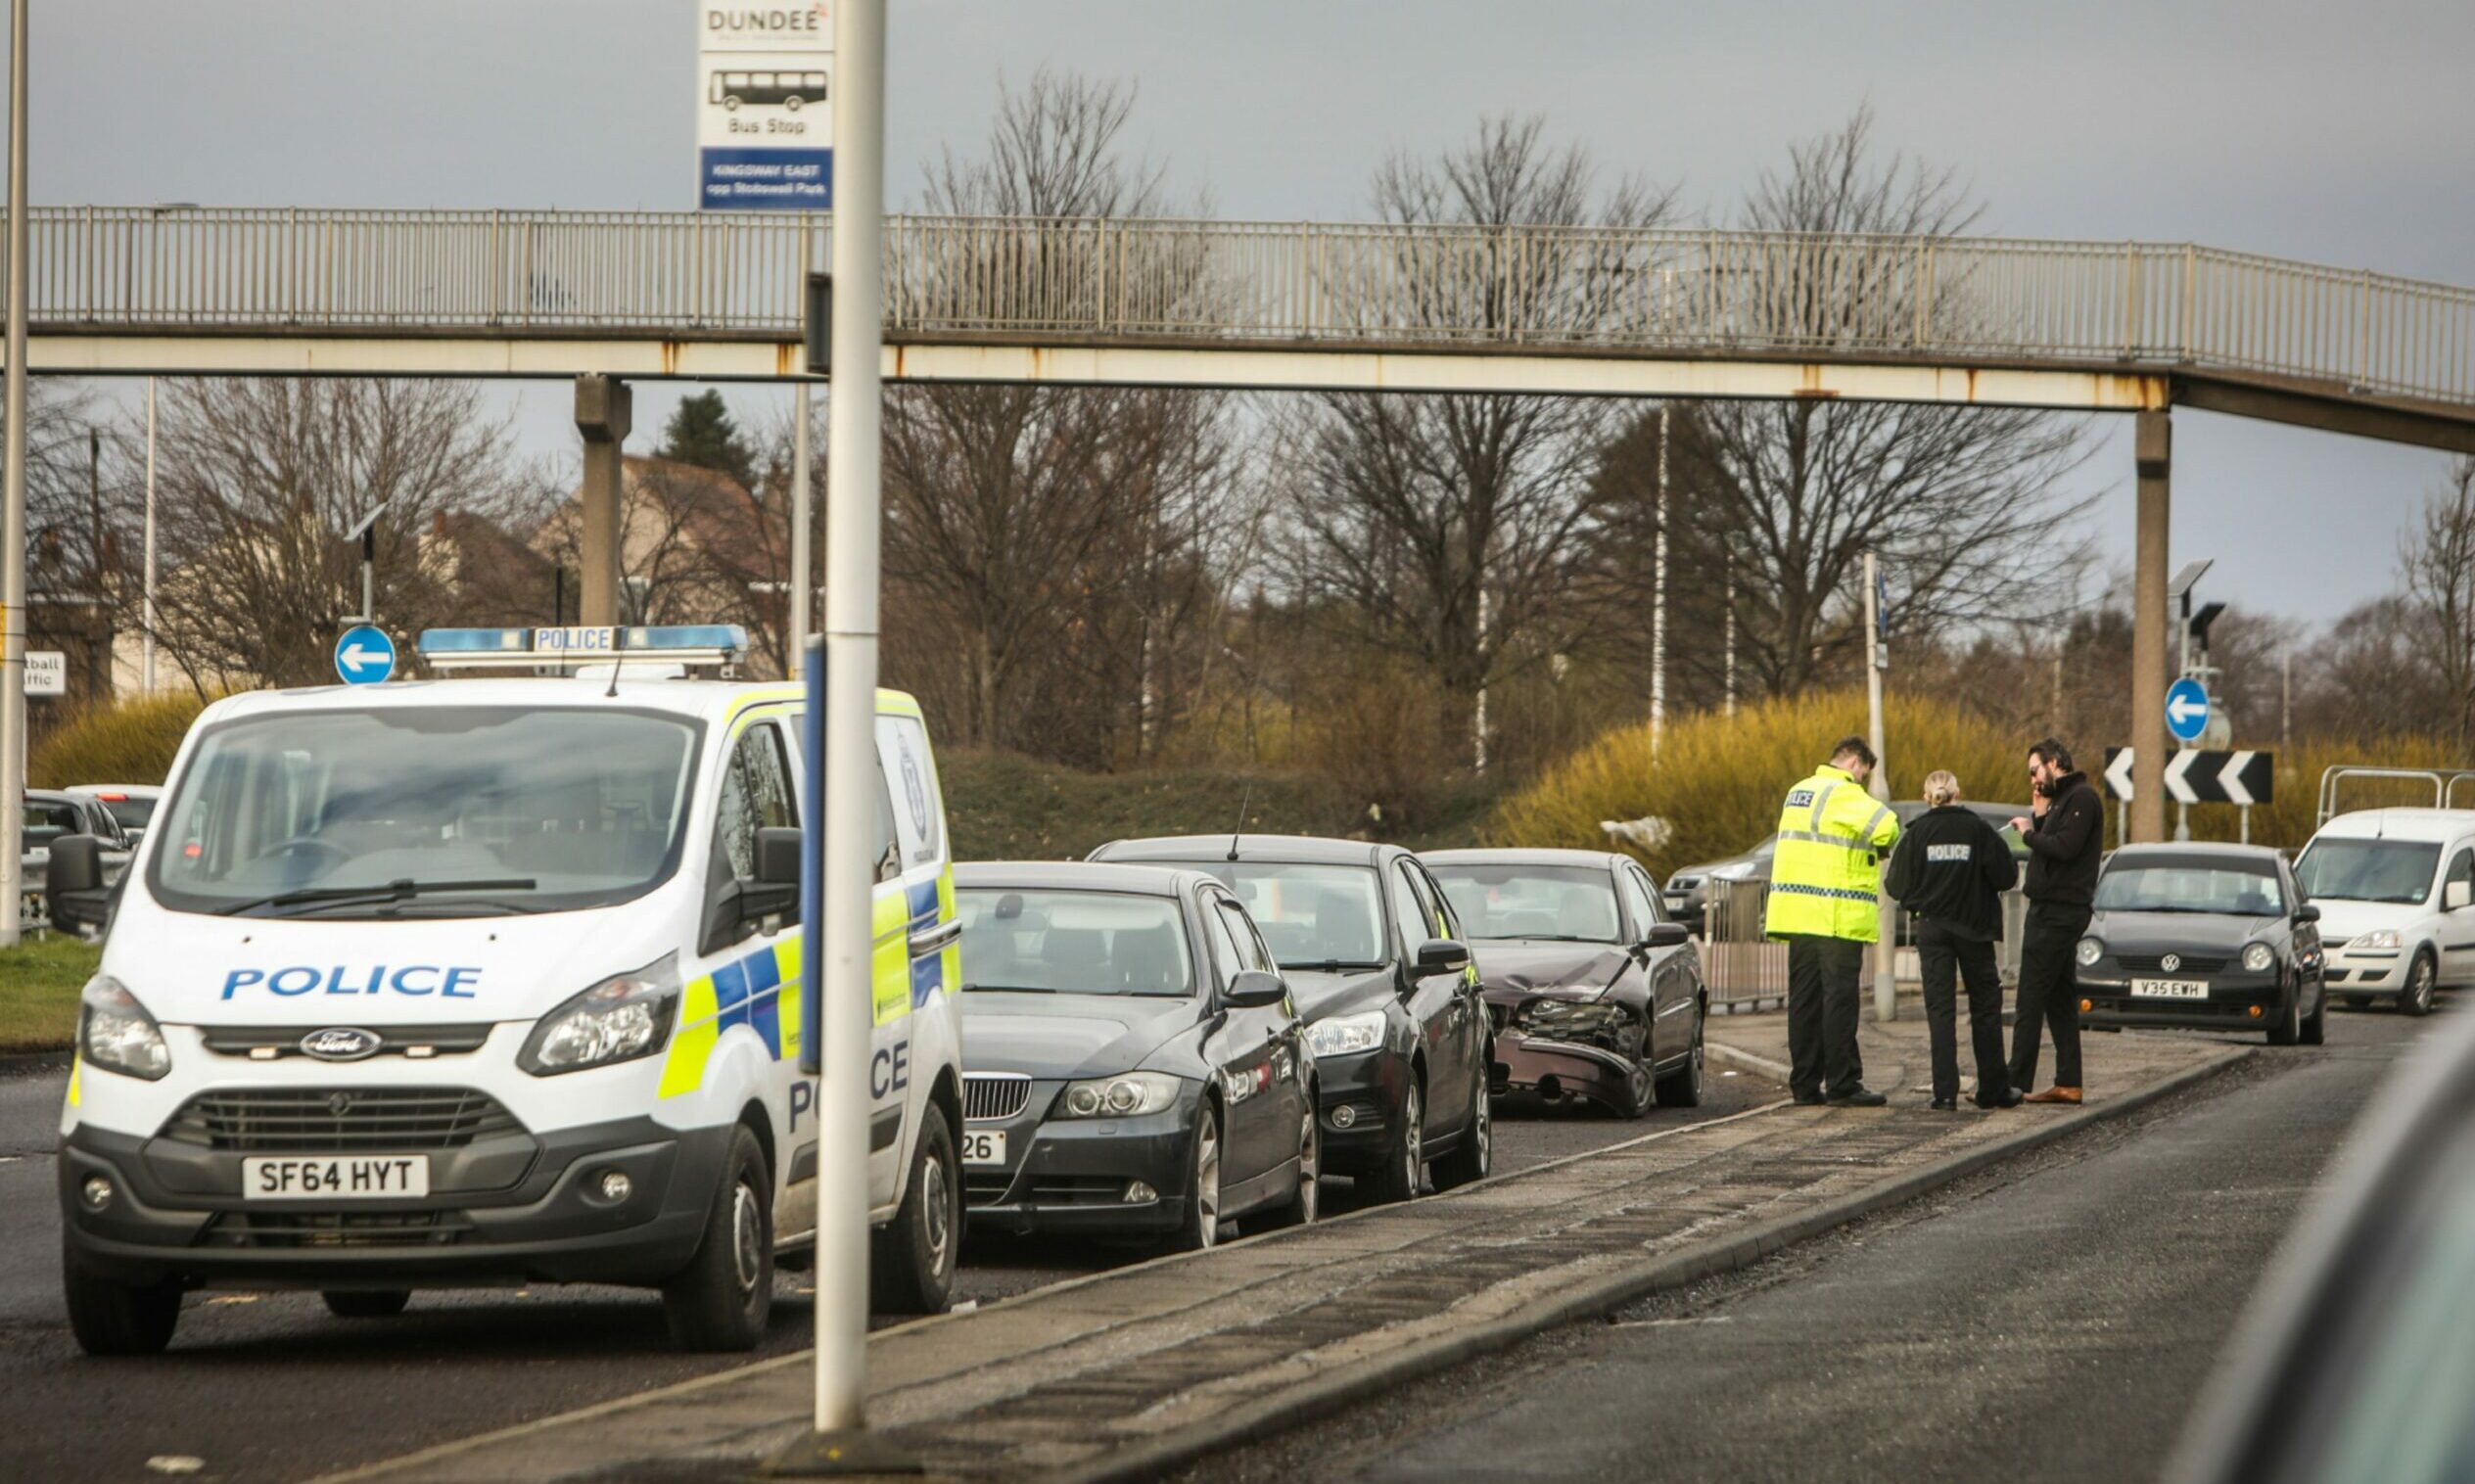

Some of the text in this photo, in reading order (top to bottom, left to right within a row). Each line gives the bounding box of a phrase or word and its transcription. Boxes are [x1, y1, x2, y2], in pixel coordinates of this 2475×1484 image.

[708, 10, 818, 30] DUNDEE
[728, 118, 806, 135] Bus Stop
[712, 164, 820, 176] KINGSWAY EAST
[795, 182, 826, 195] Park
[538, 628, 610, 650] POLICE
[1927, 844, 1971, 860] POLICE
[220, 965, 482, 1000] POLICE
[2141, 982, 2199, 996] V35 EWH
[315, 1032, 361, 1052] Ford
[259, 1161, 413, 1191] SF64 HYT
